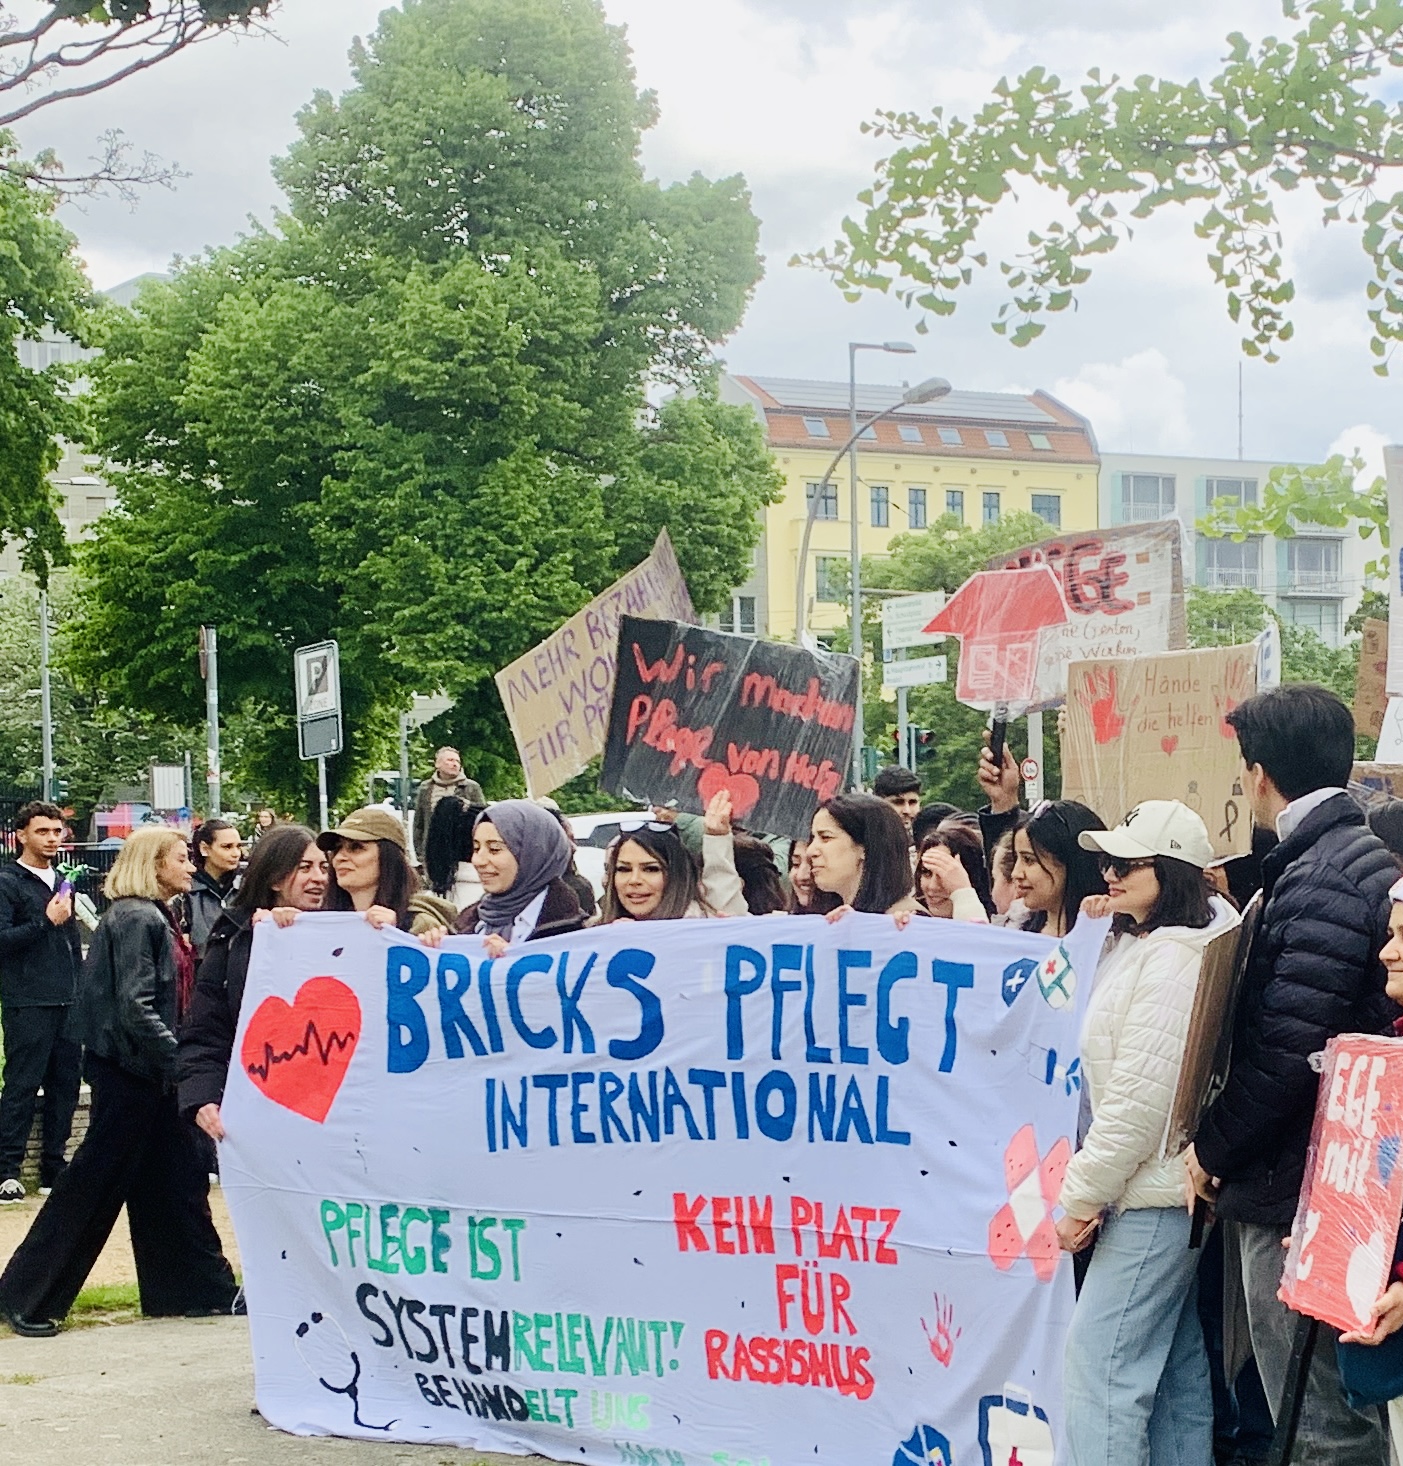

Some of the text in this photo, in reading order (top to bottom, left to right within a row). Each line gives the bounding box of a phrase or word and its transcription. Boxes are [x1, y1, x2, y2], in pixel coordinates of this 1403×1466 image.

[507, 628, 581, 712] MEHR
[631, 641, 727, 694] Wir
[1137, 701, 1214, 737] die helfen
[386, 943, 975, 1074] BRICKS PFLEGT
[485, 1066, 911, 1153] INTERNATIONAL
[320, 1199, 527, 1283] PFLEGE IST
[672, 1191, 902, 1266] KEIN PLATZ
[775, 1260, 858, 1337] FÜR
[414, 1371, 651, 1431] BEHANDELT UNS
[703, 1328, 876, 1401] RASSISMUS
